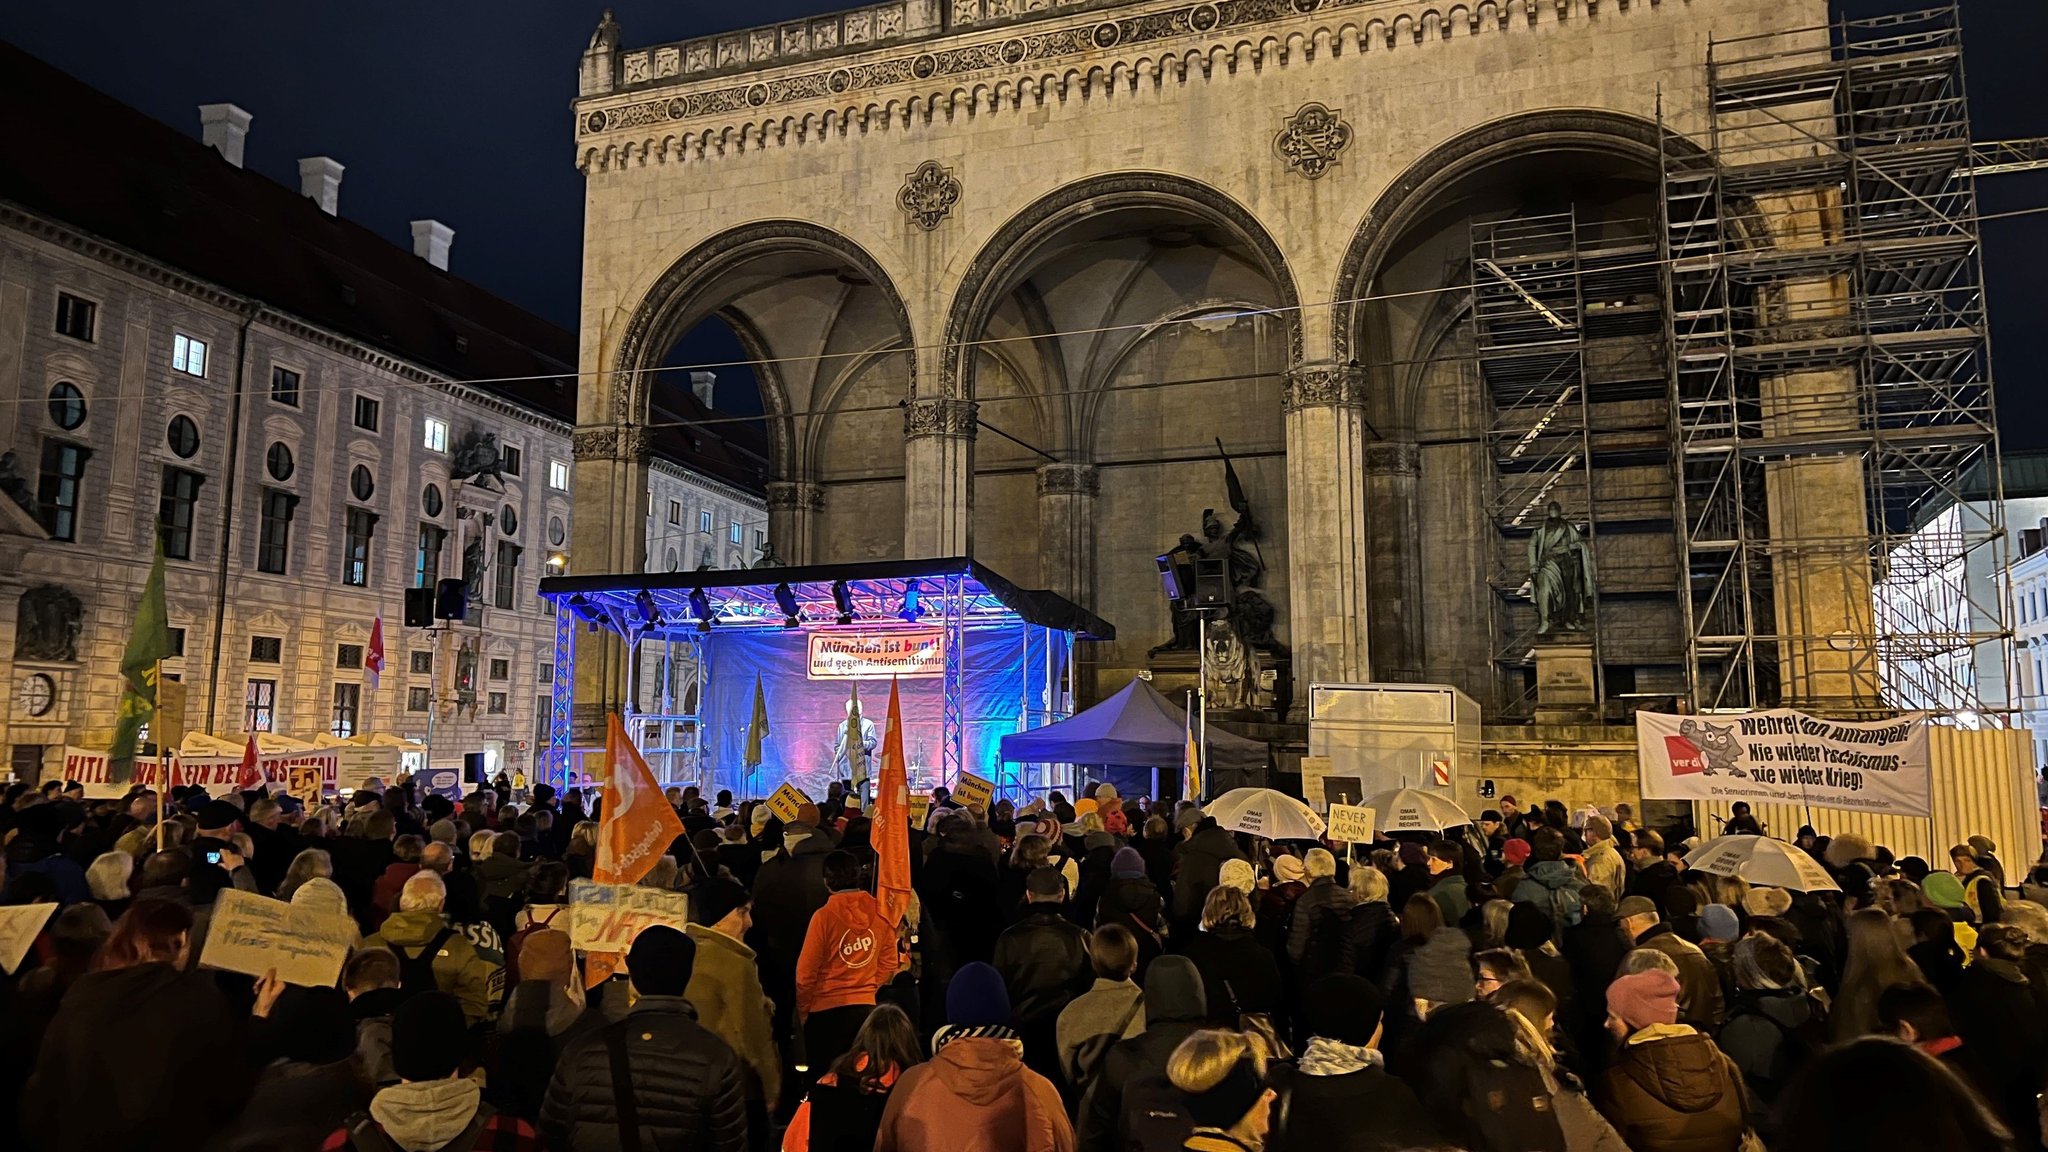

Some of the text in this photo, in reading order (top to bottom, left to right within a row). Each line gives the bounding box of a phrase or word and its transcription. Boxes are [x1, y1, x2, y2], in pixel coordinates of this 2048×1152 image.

[820, 637, 940, 653] München ist bunt!
[813, 657, 833, 668] und
[836, 659, 863, 671] gegen
[1748, 743, 1774, 761] Nie
[1775, 742, 1820, 762] wieder
[64, 755, 114, 784] HITLE
[1750, 764, 1863, 791] nie wieder Krieg!
[957, 787, 967, 797] ist
[960, 776, 990, 794] München
[782, 789, 803, 809] Münc
[782, 805, 797, 821] bun
[1242, 816, 1262, 824] GEGEN
[1246, 809, 1262, 817] OMAS
[1333, 809, 1366, 824] NEVER
[1239, 823, 1261, 831] RECHTS
[1333, 823, 1365, 837] AGAIN
[843, 936, 872, 956] ödp
